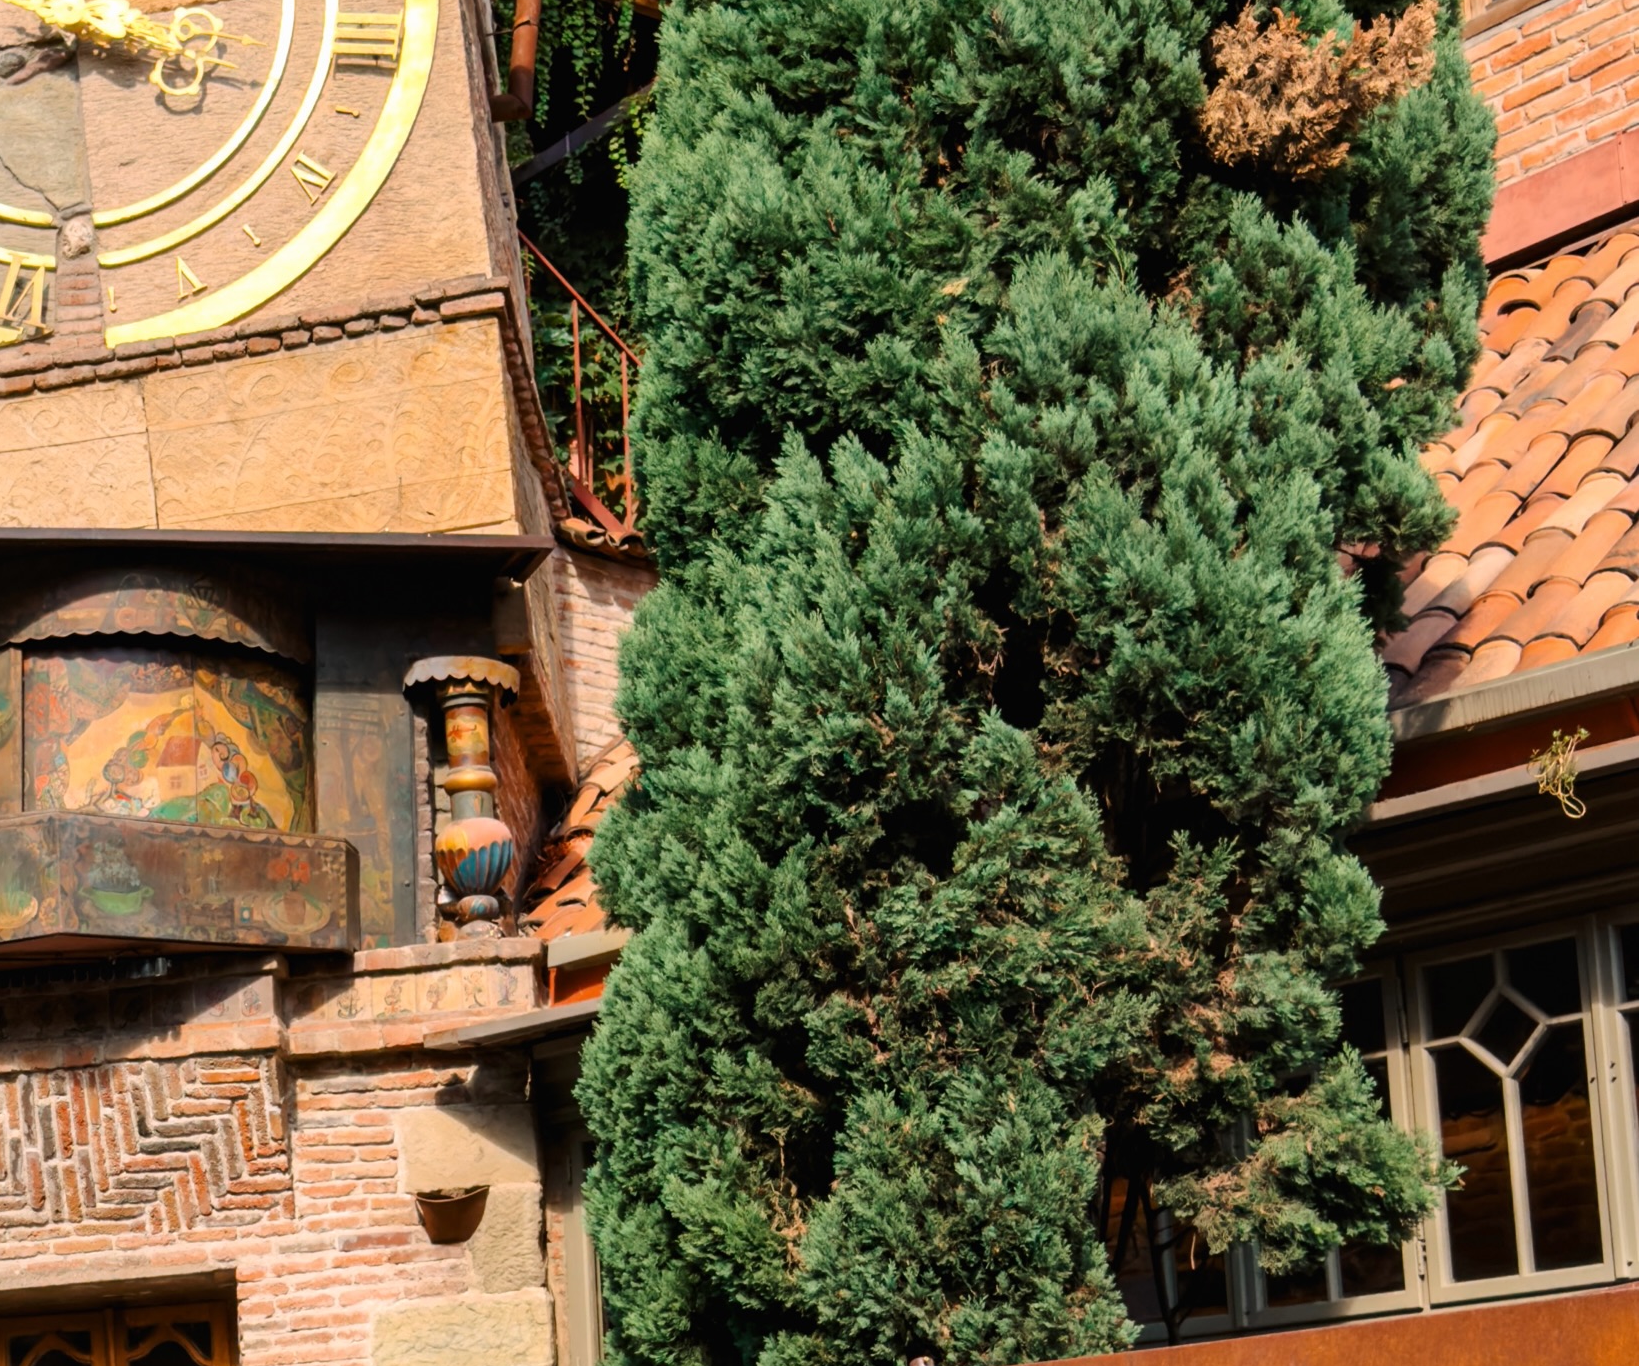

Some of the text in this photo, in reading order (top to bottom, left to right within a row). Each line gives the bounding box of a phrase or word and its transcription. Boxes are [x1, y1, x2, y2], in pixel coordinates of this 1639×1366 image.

[331, 8, 403, 61] III
[290, 149, 338, 207] IV
[176, 255, 208, 303] V
